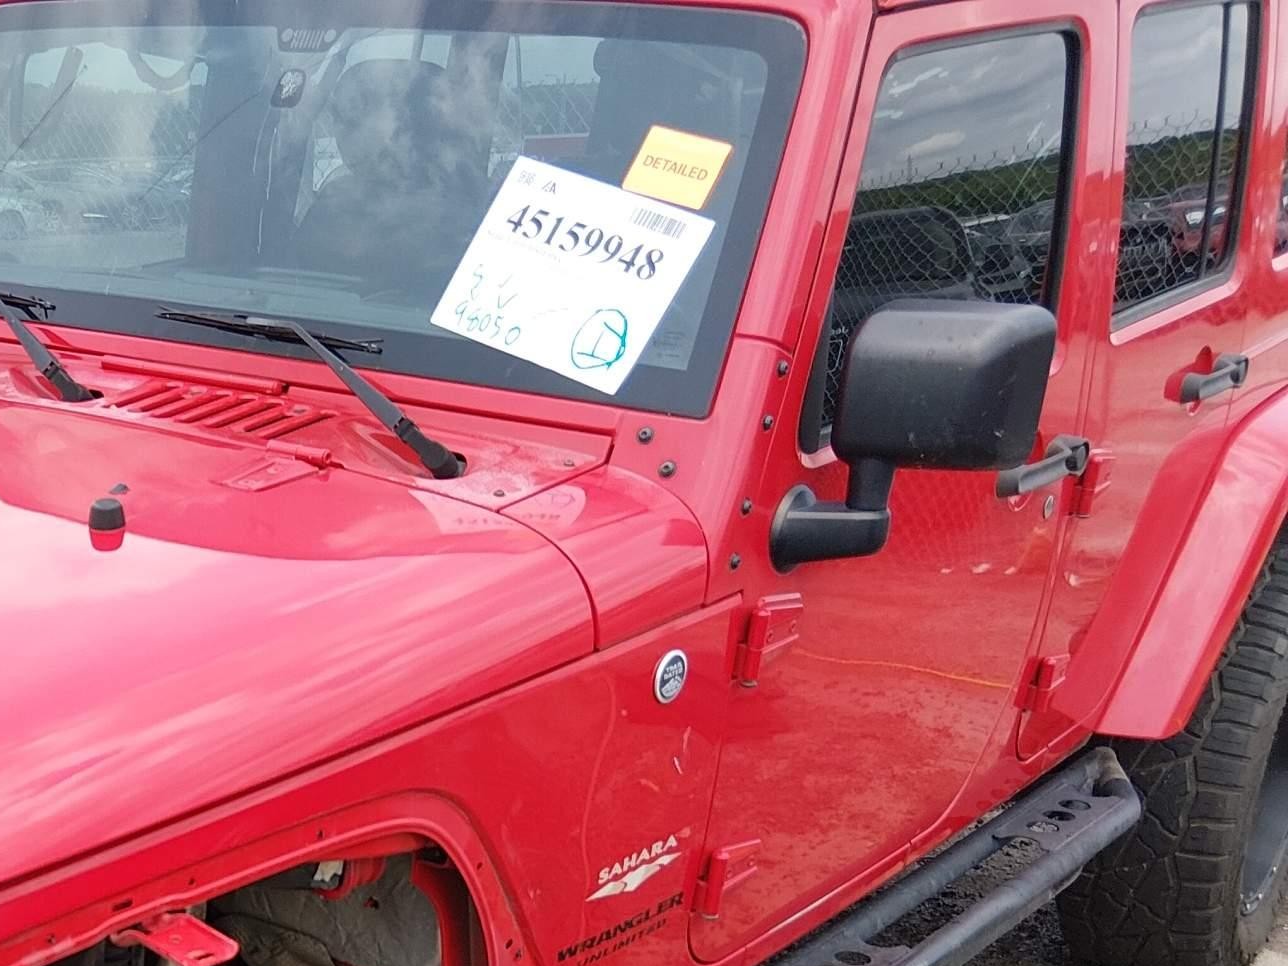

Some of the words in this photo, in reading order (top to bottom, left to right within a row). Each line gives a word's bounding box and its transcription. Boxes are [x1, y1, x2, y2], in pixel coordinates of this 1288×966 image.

[642, 154, 709, 181] DETAILED
[506, 204, 665, 280] 45159948
[597, 834, 678, 885] SAHARA
[557, 891, 684, 963] WRANGLER
